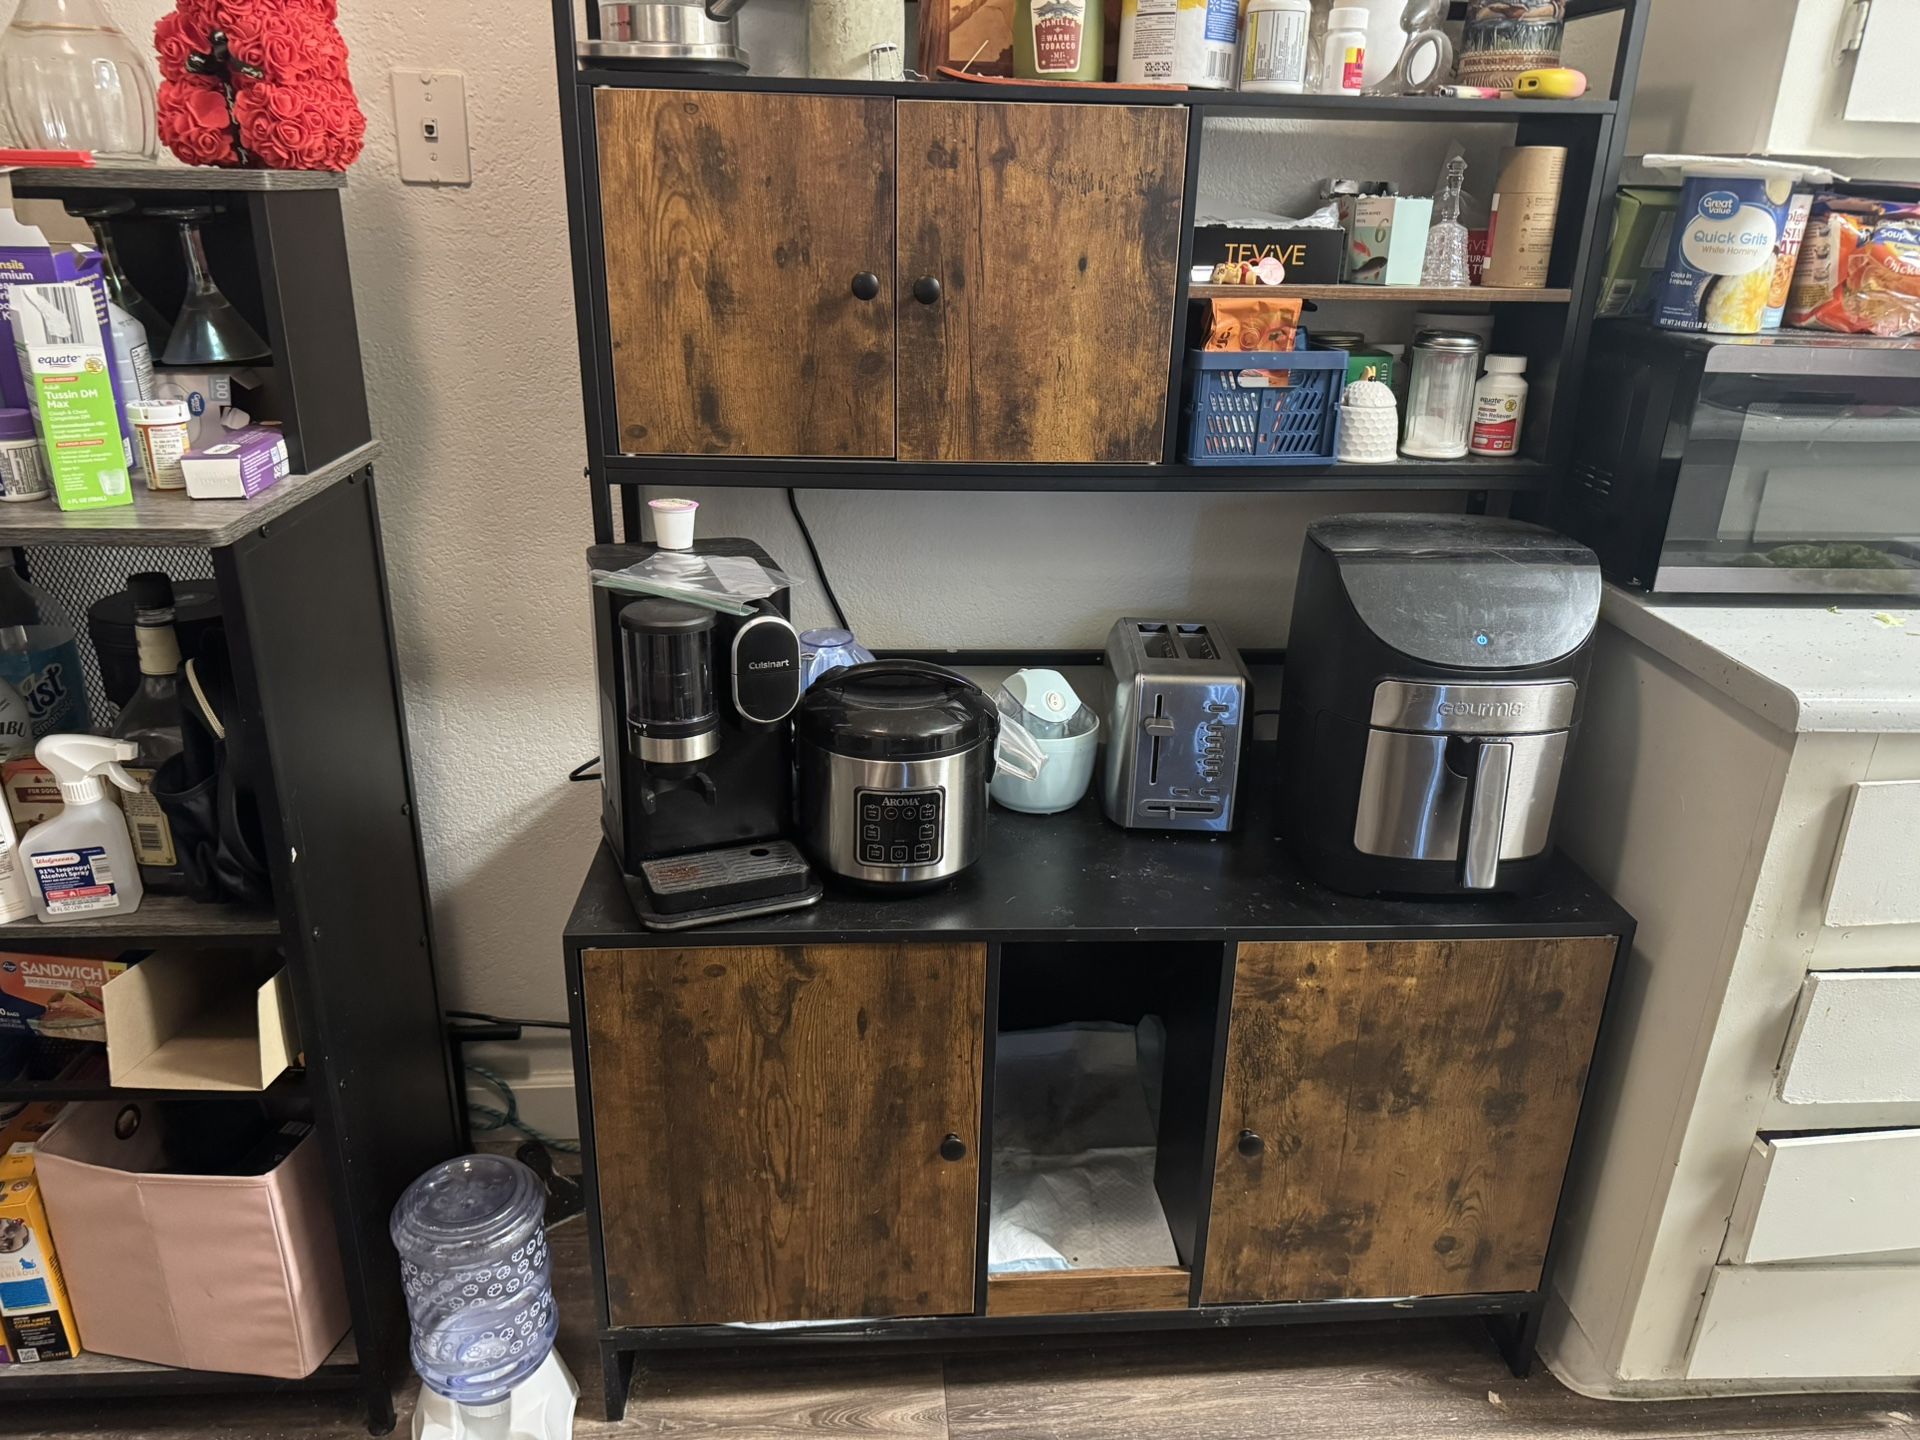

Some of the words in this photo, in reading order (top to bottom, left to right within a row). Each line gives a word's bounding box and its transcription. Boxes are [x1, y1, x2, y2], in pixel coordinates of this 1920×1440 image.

[1041, 19, 1075, 28] VANILLA
[1041, 42, 1076, 50] TOBACCO
[1703, 197, 1733, 208] Great
[1708, 205, 1732, 214] Value
[1694, 231, 1735, 244] Quick
[1740, 232, 1768, 245] Grits
[1701, 245, 1725, 254] White
[1727, 246, 1758, 256] Hominy
[38, 355, 78, 366] equate
[44, 390, 78, 400] Tussin
[80, 389, 98, 398] DM
[216, 379, 228, 399] 100
[46, 400, 70, 408] Max
[748, 659, 790, 670] Cuisinart
[882, 796, 920, 806] AROMA
[56, 864, 91, 873] Isopropyl
[20, 962, 102, 980] SANDWICH
